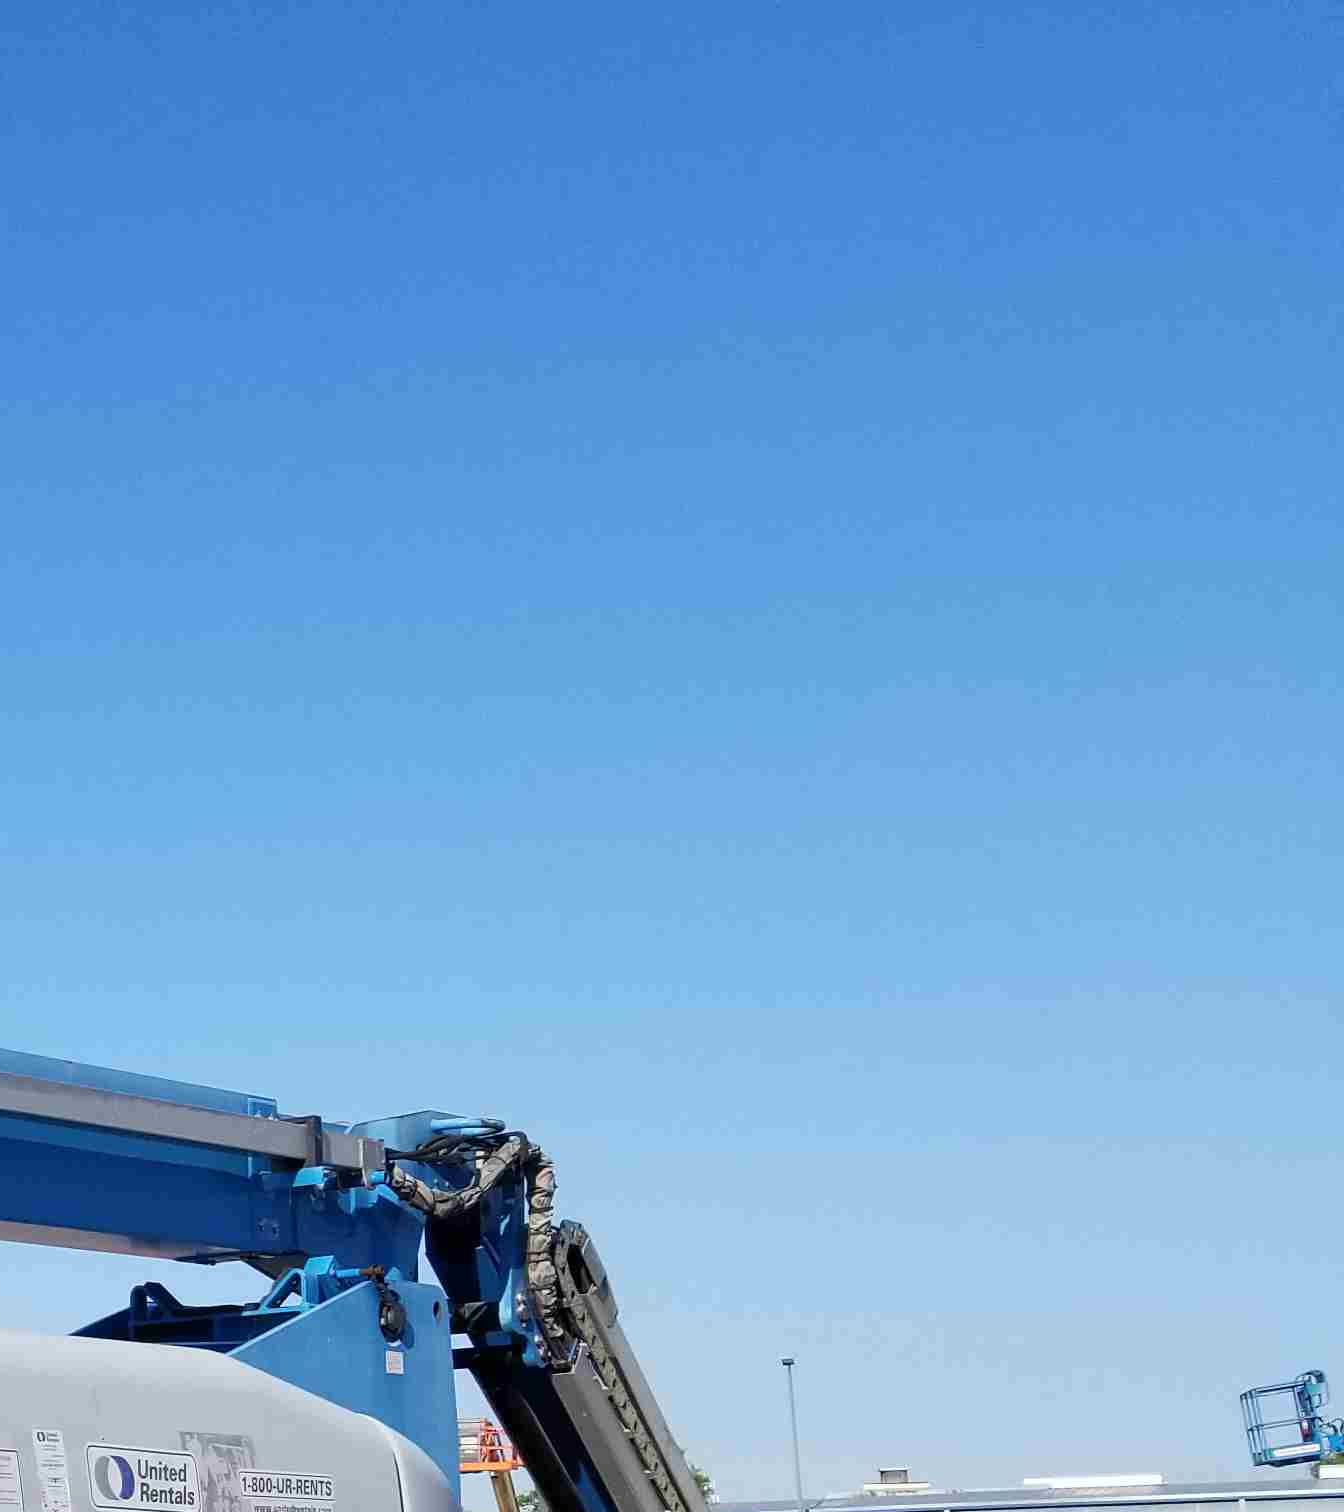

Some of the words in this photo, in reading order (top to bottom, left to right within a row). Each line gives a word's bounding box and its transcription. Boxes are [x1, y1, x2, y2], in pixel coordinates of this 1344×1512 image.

[137, 1459, 188, 1482] United
[140, 1483, 195, 1506] Rentals
[241, 1476, 333, 1497] 1-800-UR-RENTS
